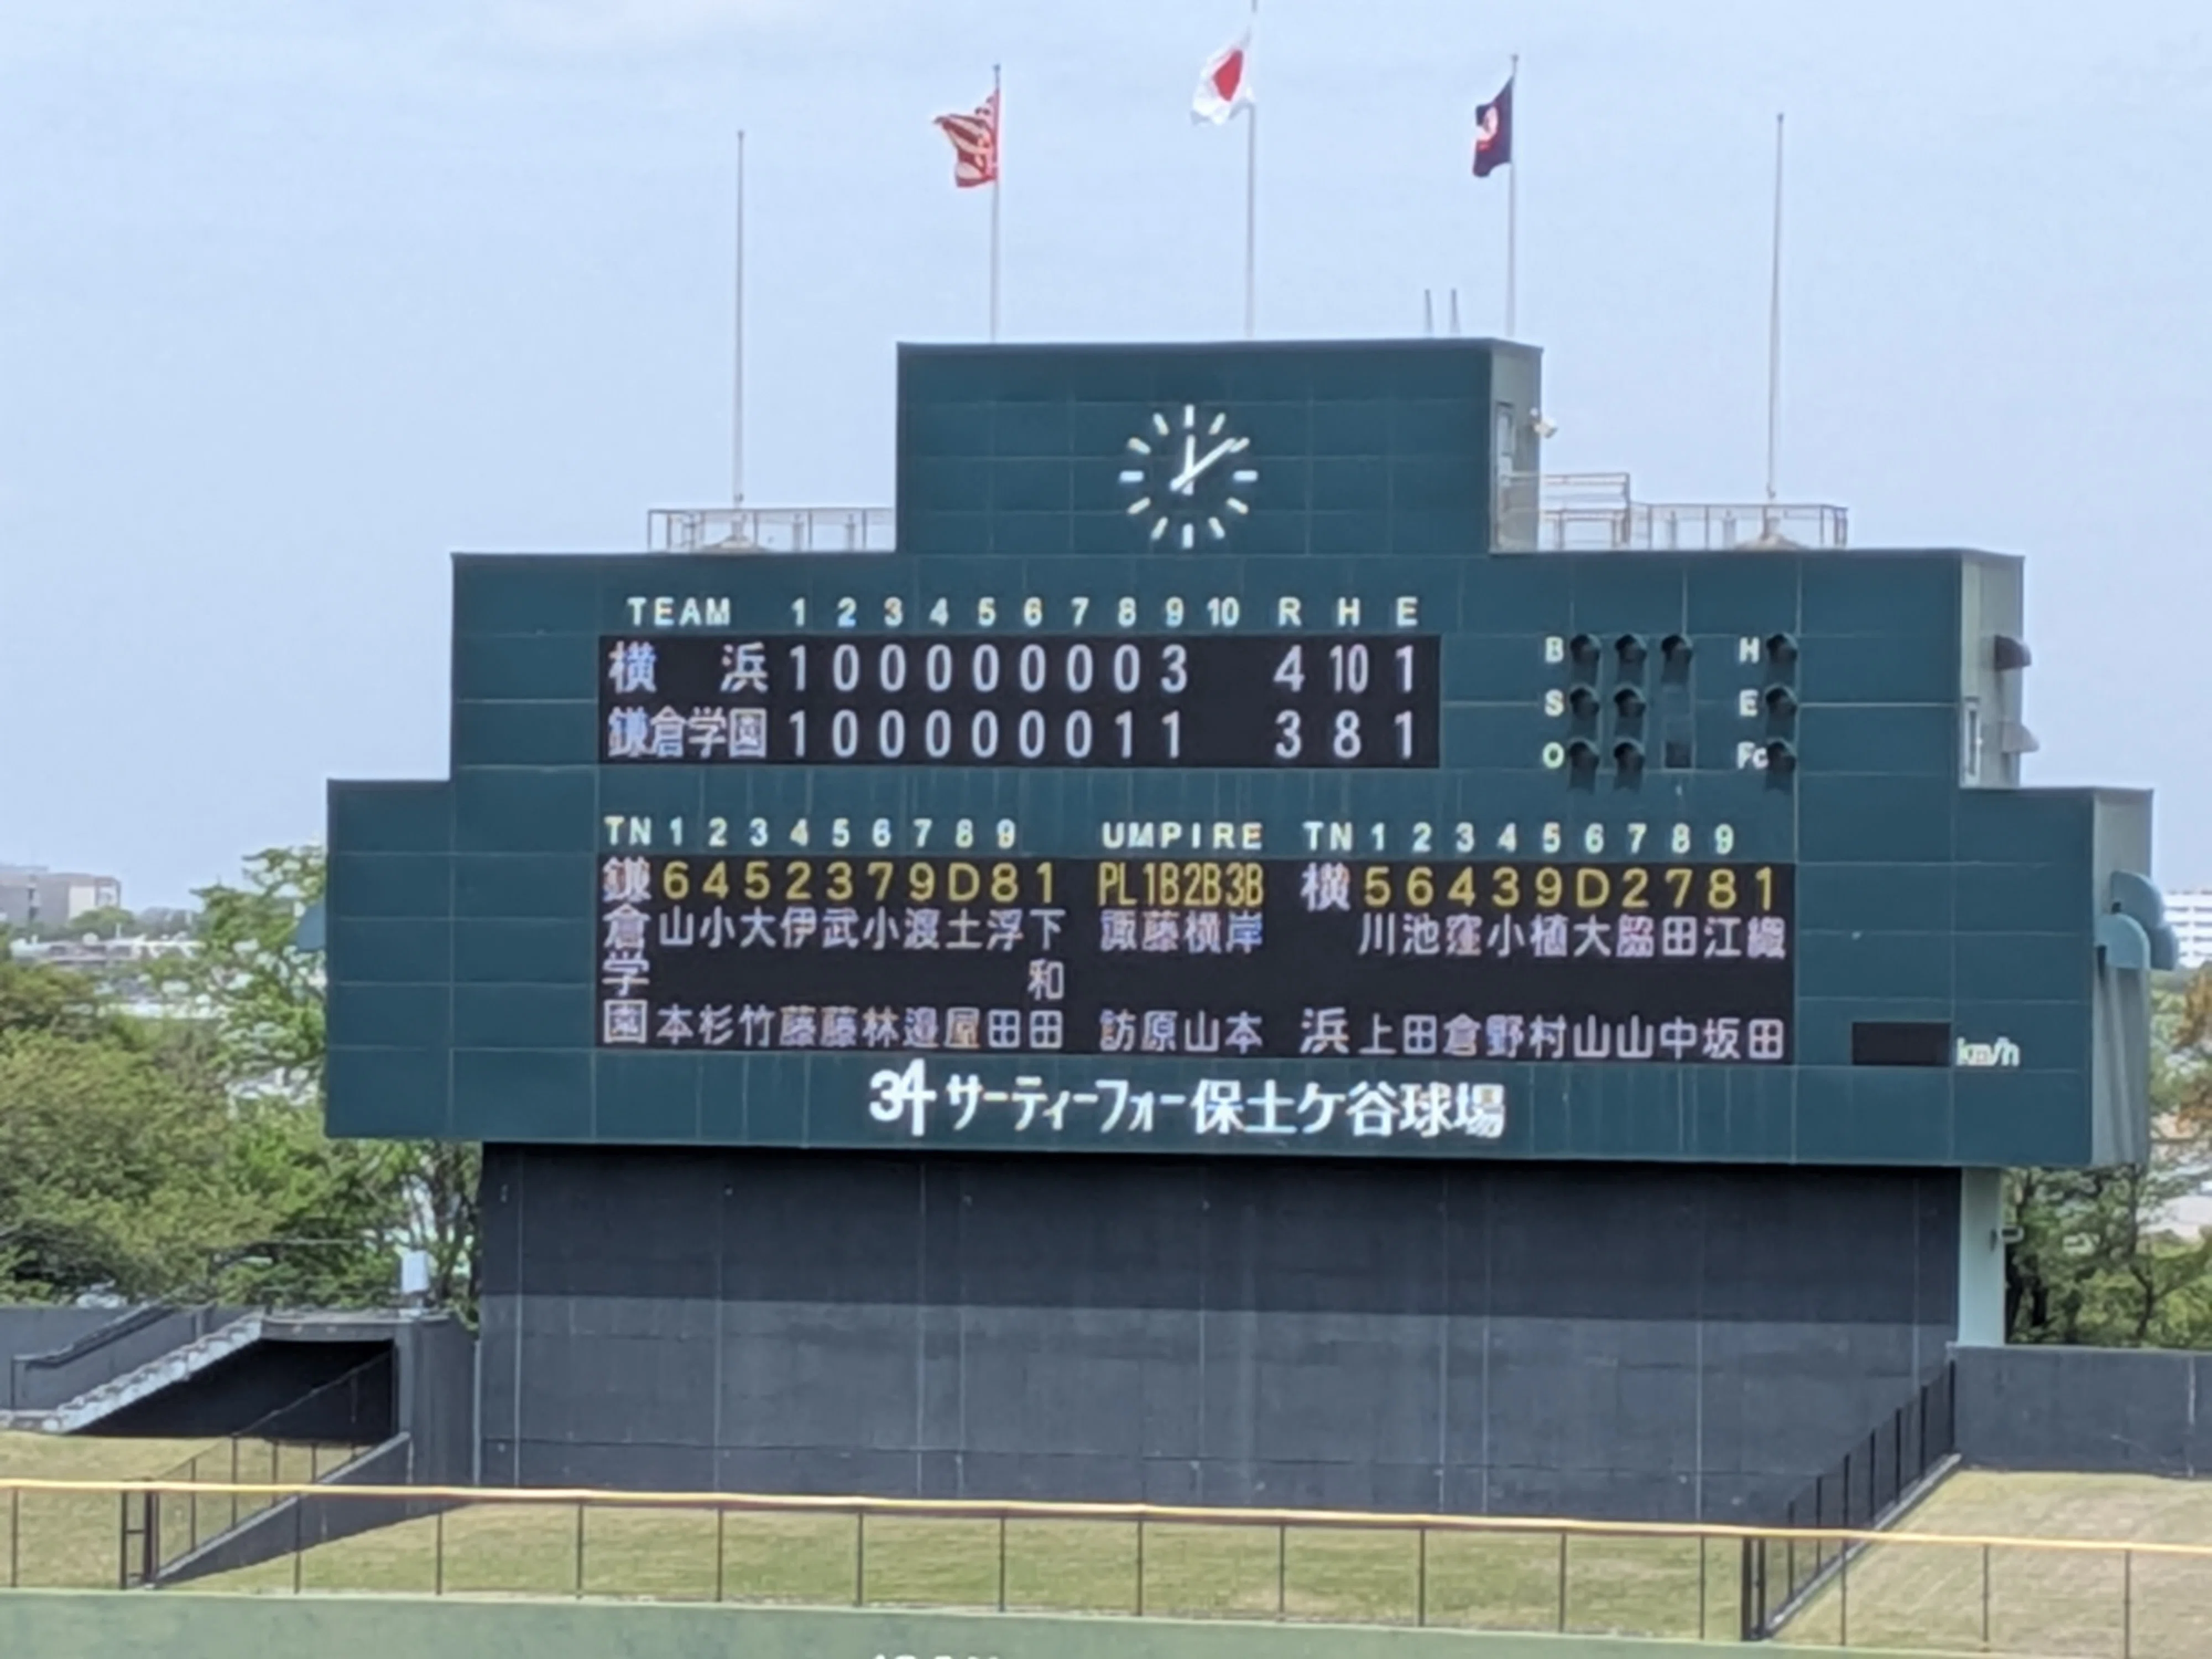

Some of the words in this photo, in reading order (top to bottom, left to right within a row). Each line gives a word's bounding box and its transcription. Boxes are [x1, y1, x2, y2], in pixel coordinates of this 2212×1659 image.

[627, 597, 730, 627] TEAM
[792, 598, 805, 627] 1
[838, 597, 856, 628] 2
[884, 597, 903, 627] 3
[930, 598, 948, 626] 4
[978, 597, 996, 627] 5
[1024, 597, 1042, 627] 6
[1072, 597, 1089, 627] 7
[1118, 597, 1136, 628] 8
[1165, 597, 1184, 628] 9
[1207, 597, 1239, 627] 10
[1278, 597, 1301, 627] R
[1337, 597, 1360, 627] H
[1396, 597, 1417, 628] E
[1545, 637, 1564, 664] B
[1739, 637, 1760, 663] H
[609, 641, 768, 693] 横浜
[790, 645, 806, 691] 1
[833, 644, 859, 692] 0
[880, 644, 906, 692] 0
[926, 644, 952, 692] 0
[973, 644, 999, 692] 0
[1020, 644, 1046, 692] 0
[1067, 644, 1093, 692] 0
[1114, 644, 1140, 692] 0
[1161, 644, 1187, 693] 3
[1274, 645, 1305, 692] 4
[1330, 644, 1368, 693] 10
[1396, 645, 1413, 692] 1
[1545, 689, 1564, 717] S
[1739, 689, 1758, 717] E
[608, 706, 766, 758] 鎌倉学園
[790, 711, 805, 757] 1
[832, 709, 858, 758] 0
[879, 709, 905, 758] 0
[925, 709, 951, 758] 0
[972, 710, 998, 758] 0
[1019, 710, 1045, 758] 0
[1065, 710, 1092, 758] 0
[1115, 711, 1132, 758] 1
[1162, 711, 1179, 758] 1
[1276, 709, 1301, 759] 3
[1333, 710, 1361, 759] 8
[1395, 711, 1412, 758] 1
[1542, 742, 1564, 769] O
[605, 816, 651, 846] TN
[670, 817, 682, 846] 1
[709, 817, 727, 846] 2
[750, 818, 768, 847] 3
[790, 818, 808, 846] 4
[832, 818, 850, 847] 5
[872, 818, 891, 847] 6
[914, 818, 932, 847] 7
[956, 818, 973, 848] 8
[997, 818, 1015, 849] 9
[1102, 822, 1261, 850] UMPIRE
[1303, 821, 1352, 851] TN
[1371, 822, 1384, 851] 1
[1412, 822, 1431, 852] 2
[1455, 822, 1474, 853] 3
[1498, 823, 1516, 852] 4
[1542, 822, 1561, 853] 5
[1584, 823, 1604, 854] 6
[1628, 823, 1646, 853] 7
[1671, 823, 1691, 854] 8
[1714, 823, 1734, 855] 9
[663, 861, 688, 899] 6
[702, 861, 729, 899] 4
[745, 860, 770, 899] 5
[786, 861, 811, 900] 2
[827, 862, 853, 901] 3
[868, 862, 893, 900] 7
[910, 862, 935, 901] 9
[948, 862, 980, 901] D
[991, 863, 1018, 902] 8
[1037, 862, 1052, 903] 1
[1099, 862, 1137, 906] PL
[1144, 862, 1180, 906] 1B
[1183, 862, 1222, 906] 2B
[1225, 862, 1264, 907] 3B
[1365, 867, 1391, 906] 5
[1407, 867, 1433, 906] 6
[1448, 867, 1475, 906] 4
[1493, 867, 1519, 907] 3
[1535, 867, 1562, 907] 9
[1577, 868, 1609, 908] D
[1622, 868, 1648, 908] 2
[1665, 868, 1693, 908] 7
[1708, 869, 1736, 909] 8
[1756, 867, 1771, 911] 1
[603, 856, 651, 1044] 鎌倉学園
[1300, 862, 1350, 1053] 横浜
[1956, 1037, 2020, 1066] km/h
